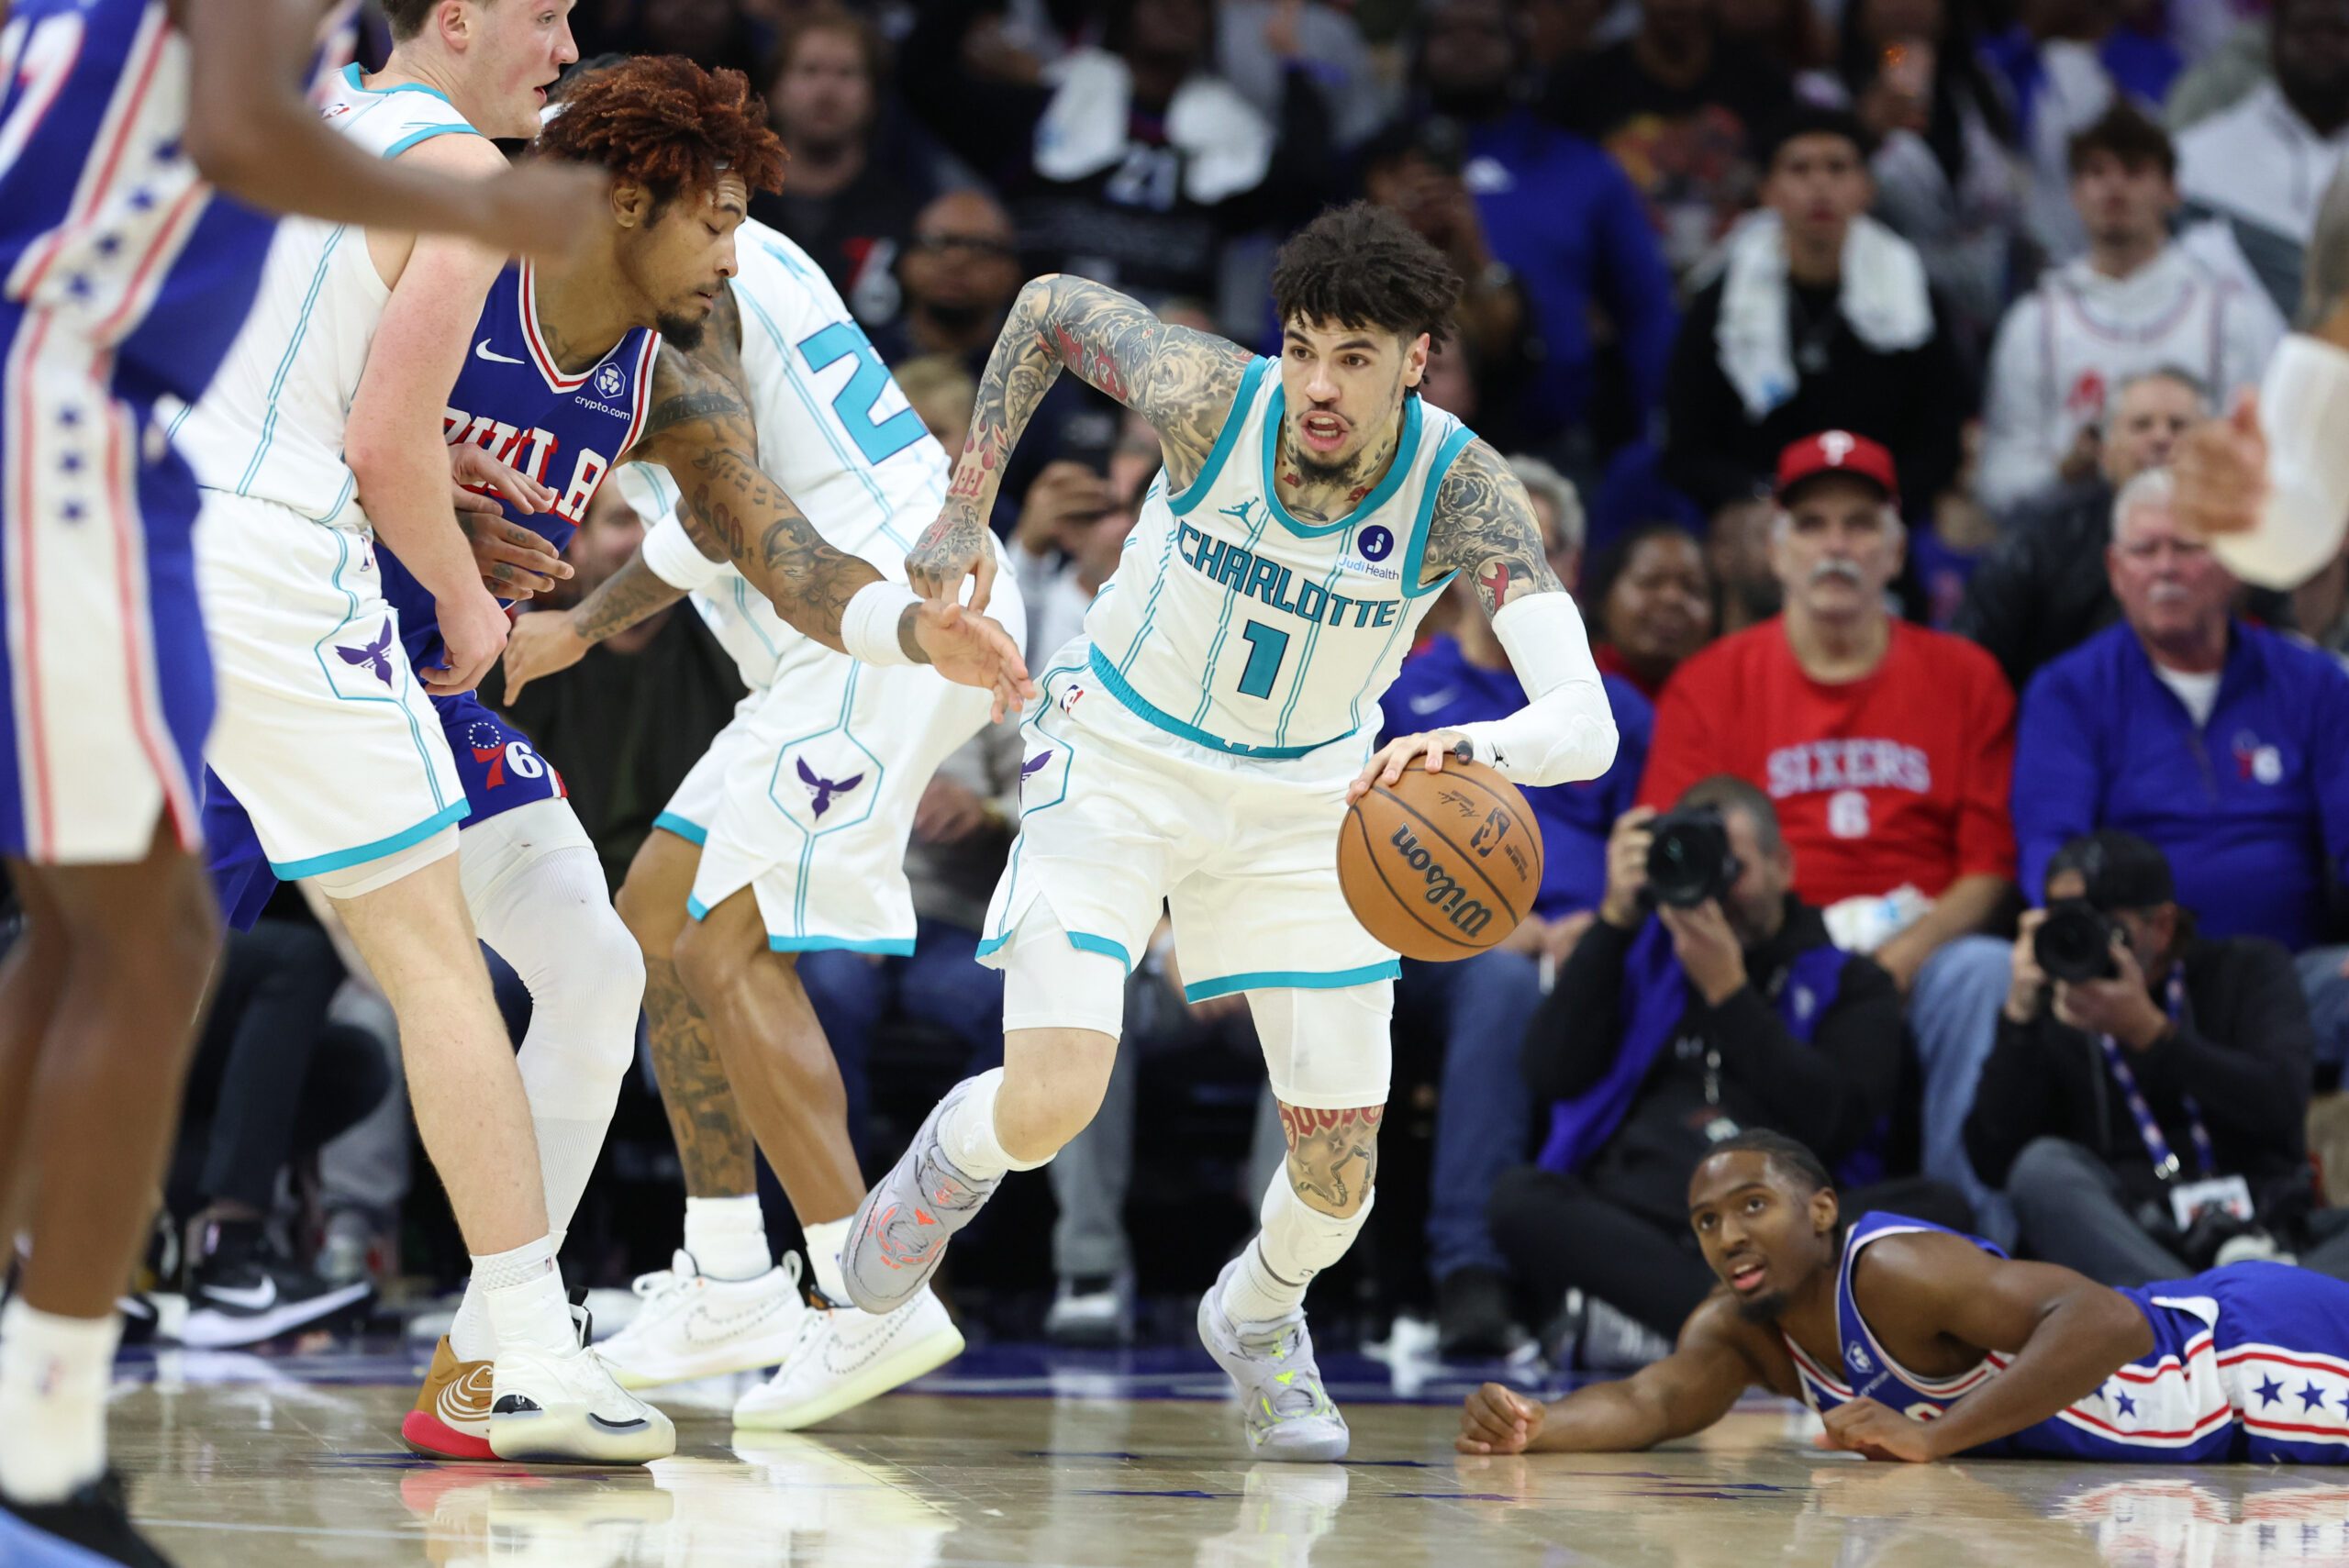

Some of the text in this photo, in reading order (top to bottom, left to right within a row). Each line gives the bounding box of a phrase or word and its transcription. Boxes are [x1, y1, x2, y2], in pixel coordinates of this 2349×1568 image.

[574, 395, 631, 421] crypto.com
[1177, 519, 1400, 628] CHARLOTTE
[1339, 556, 1400, 581] Judi Health
[1236, 618, 1290, 700] 1
[471, 741, 543, 792] 76
[1766, 738, 1933, 799] SIXERS
[1389, 821, 1494, 939] Wilson
